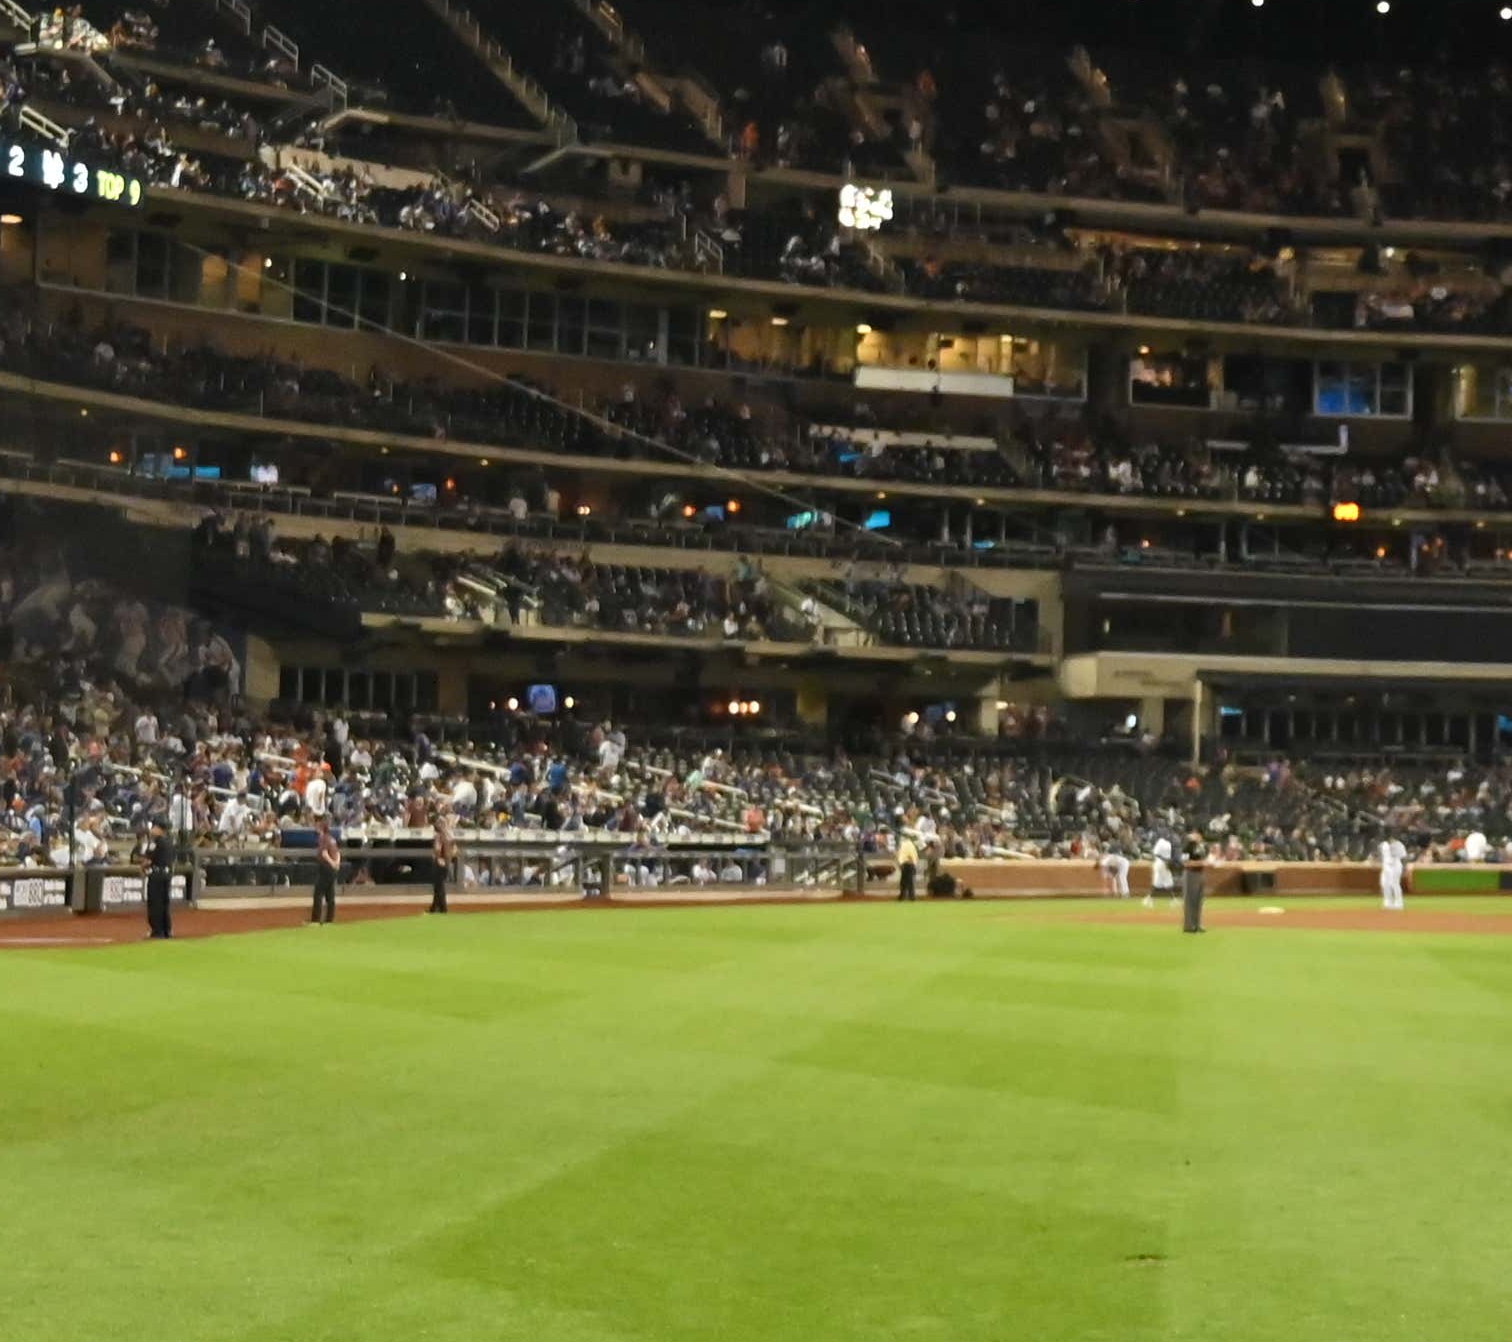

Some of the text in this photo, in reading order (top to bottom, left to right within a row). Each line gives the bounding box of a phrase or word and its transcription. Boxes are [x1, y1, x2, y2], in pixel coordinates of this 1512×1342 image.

[8, 144, 25, 177] 2
[73, 162, 88, 193] 3
[96, 170, 125, 201] TOP
[129, 179, 141, 206] 9
